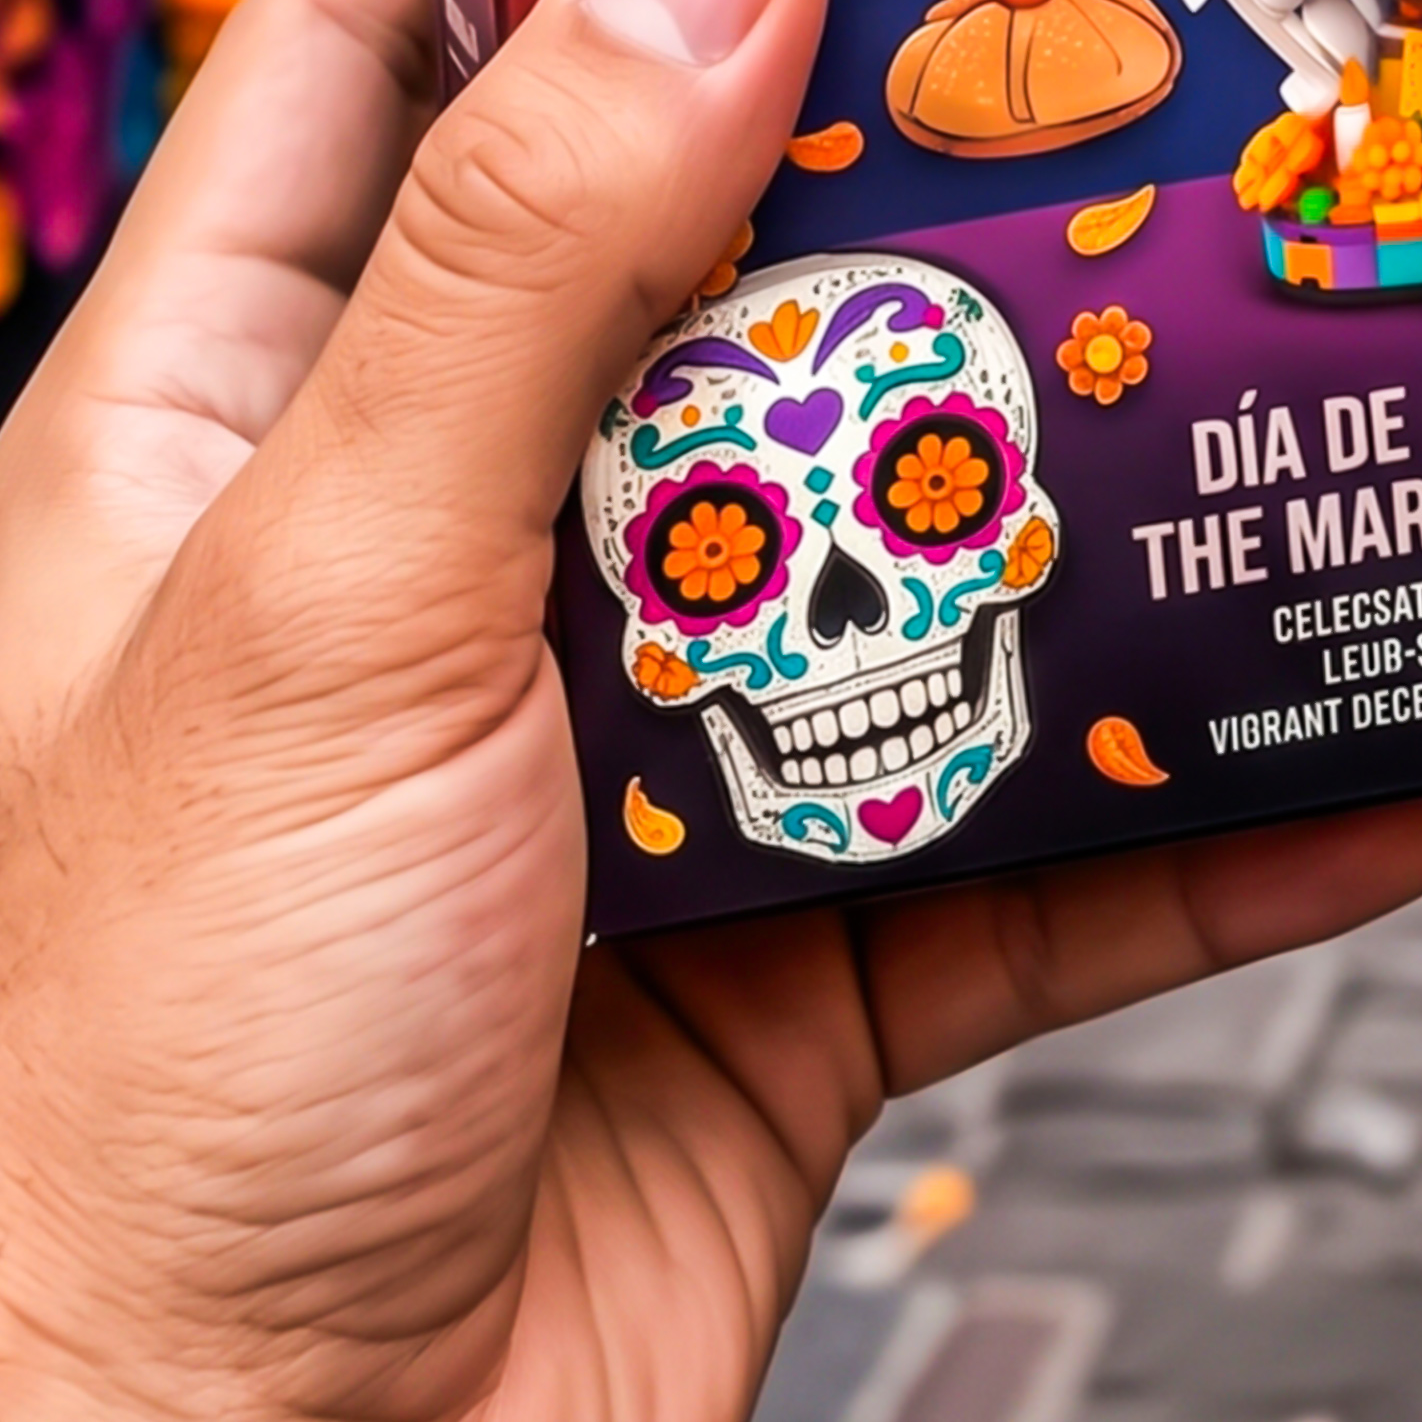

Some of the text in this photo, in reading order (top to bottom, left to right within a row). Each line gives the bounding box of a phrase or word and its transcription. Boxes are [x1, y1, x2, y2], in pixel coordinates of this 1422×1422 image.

[1192, 389, 1306, 495] DÍA
[1323, 386, 1410, 473] DE
[1132, 506, 1268, 600] THE
